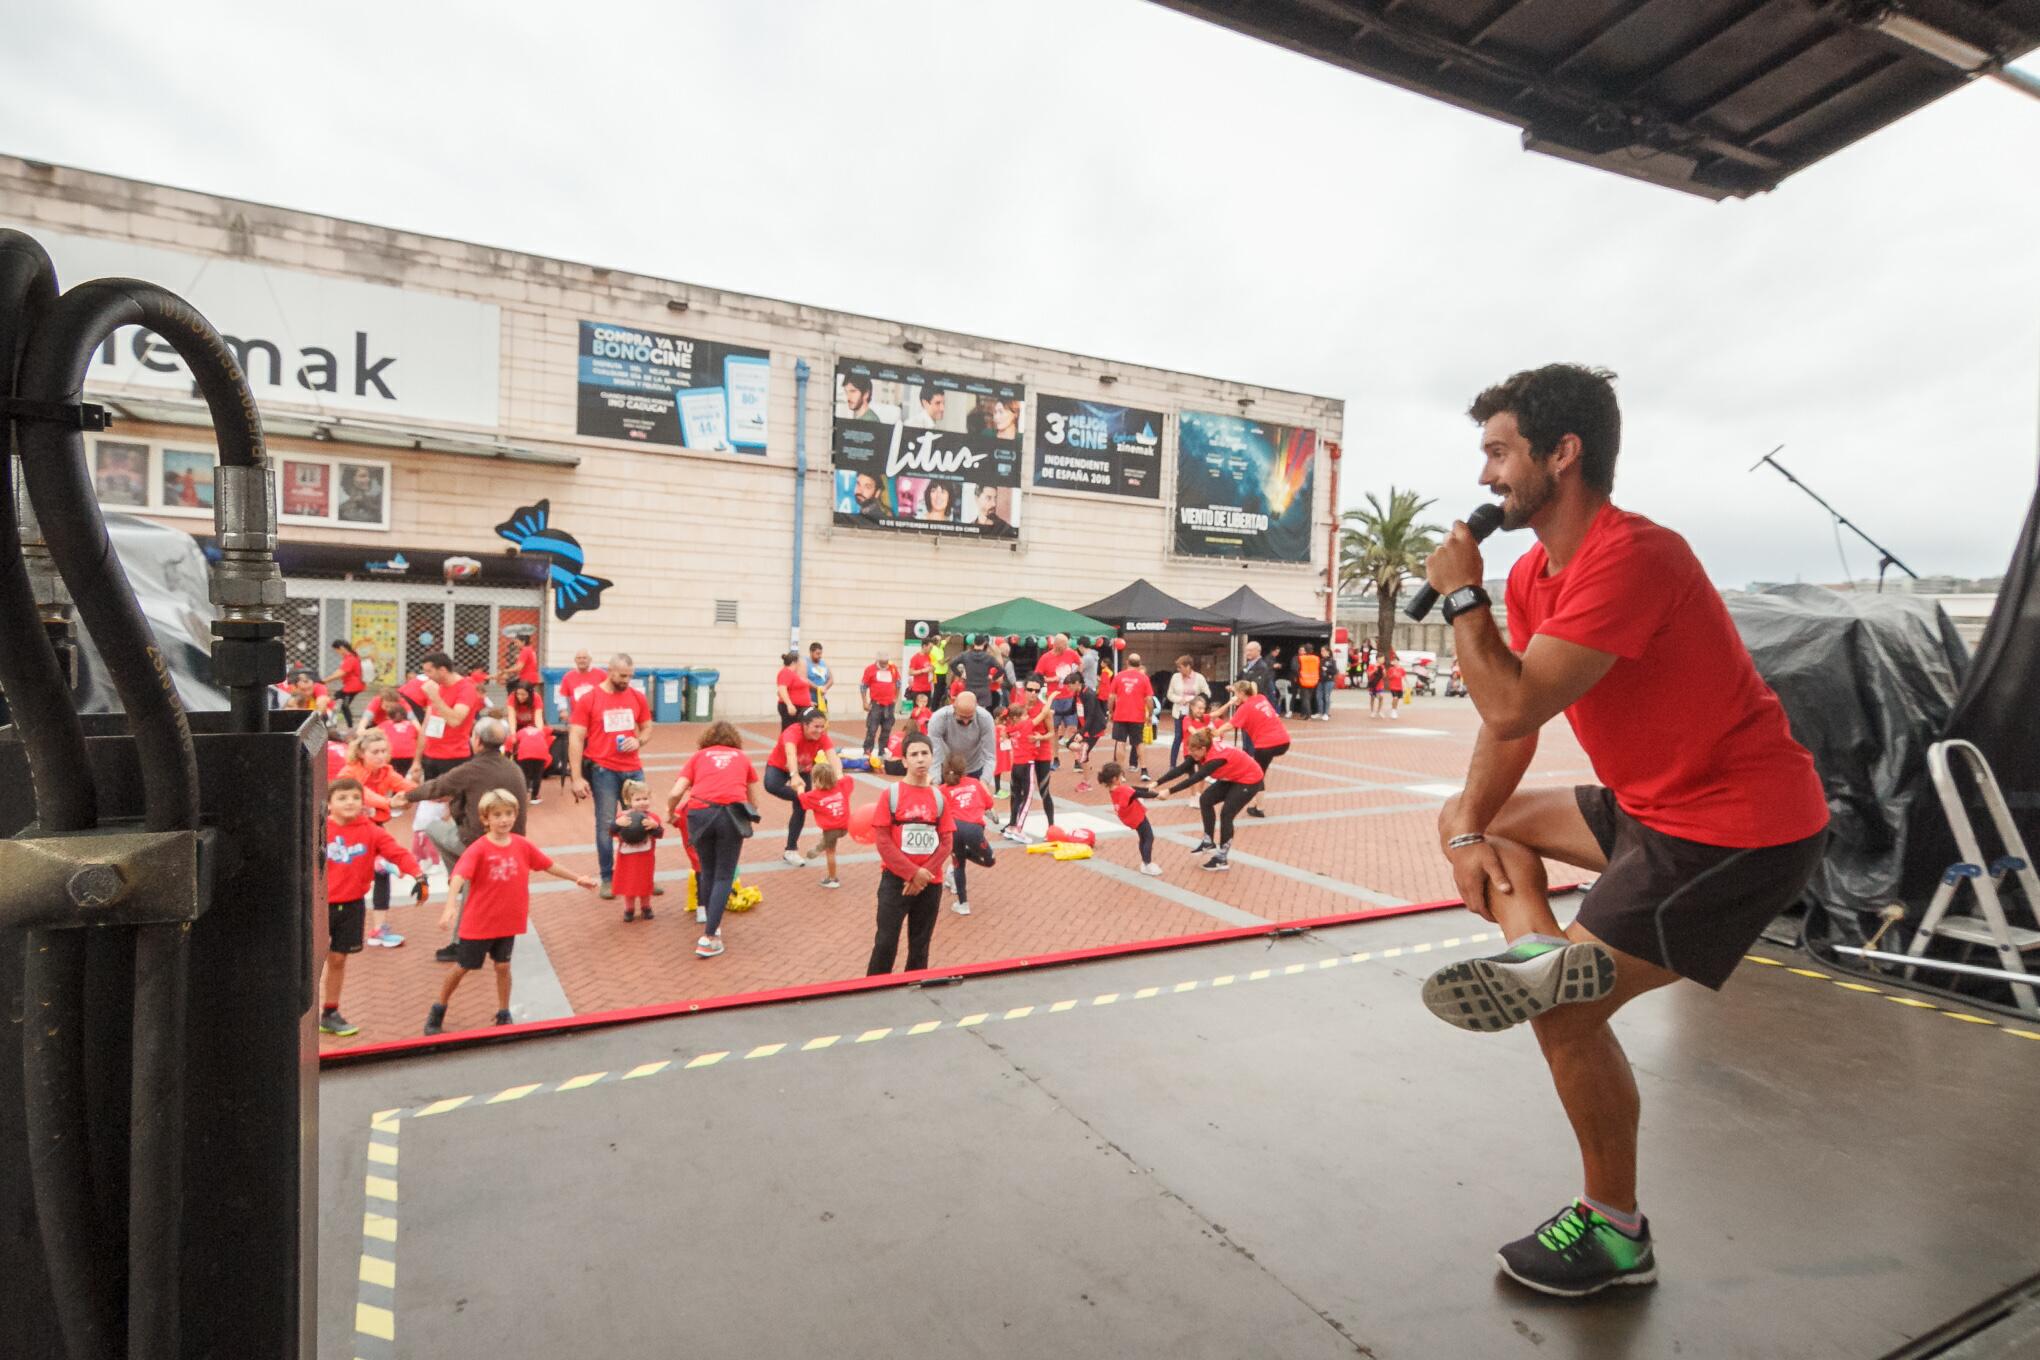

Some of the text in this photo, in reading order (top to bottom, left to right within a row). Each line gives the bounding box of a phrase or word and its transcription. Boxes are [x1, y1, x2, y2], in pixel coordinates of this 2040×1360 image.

[594, 328, 694, 353] COMPRA YA TU
[593, 340, 692, 369] BONOCINE
[1069, 415, 1108, 433] MEJOR
[1067, 427, 1108, 450] CINE
[1117, 441, 1155, 457] zinemak
[1044, 454, 1110, 473] INDEPENDIENTE
[1042, 467, 1054, 478] DE
[1055, 469, 1089, 482] ESPAÑA
[1181, 507, 1214, 526] VIENTO
[1214, 510, 1227, 527] DE
[1227, 511, 1269, 531] LIBERTAD
[1126, 622, 1167, 631] EL CORREO
